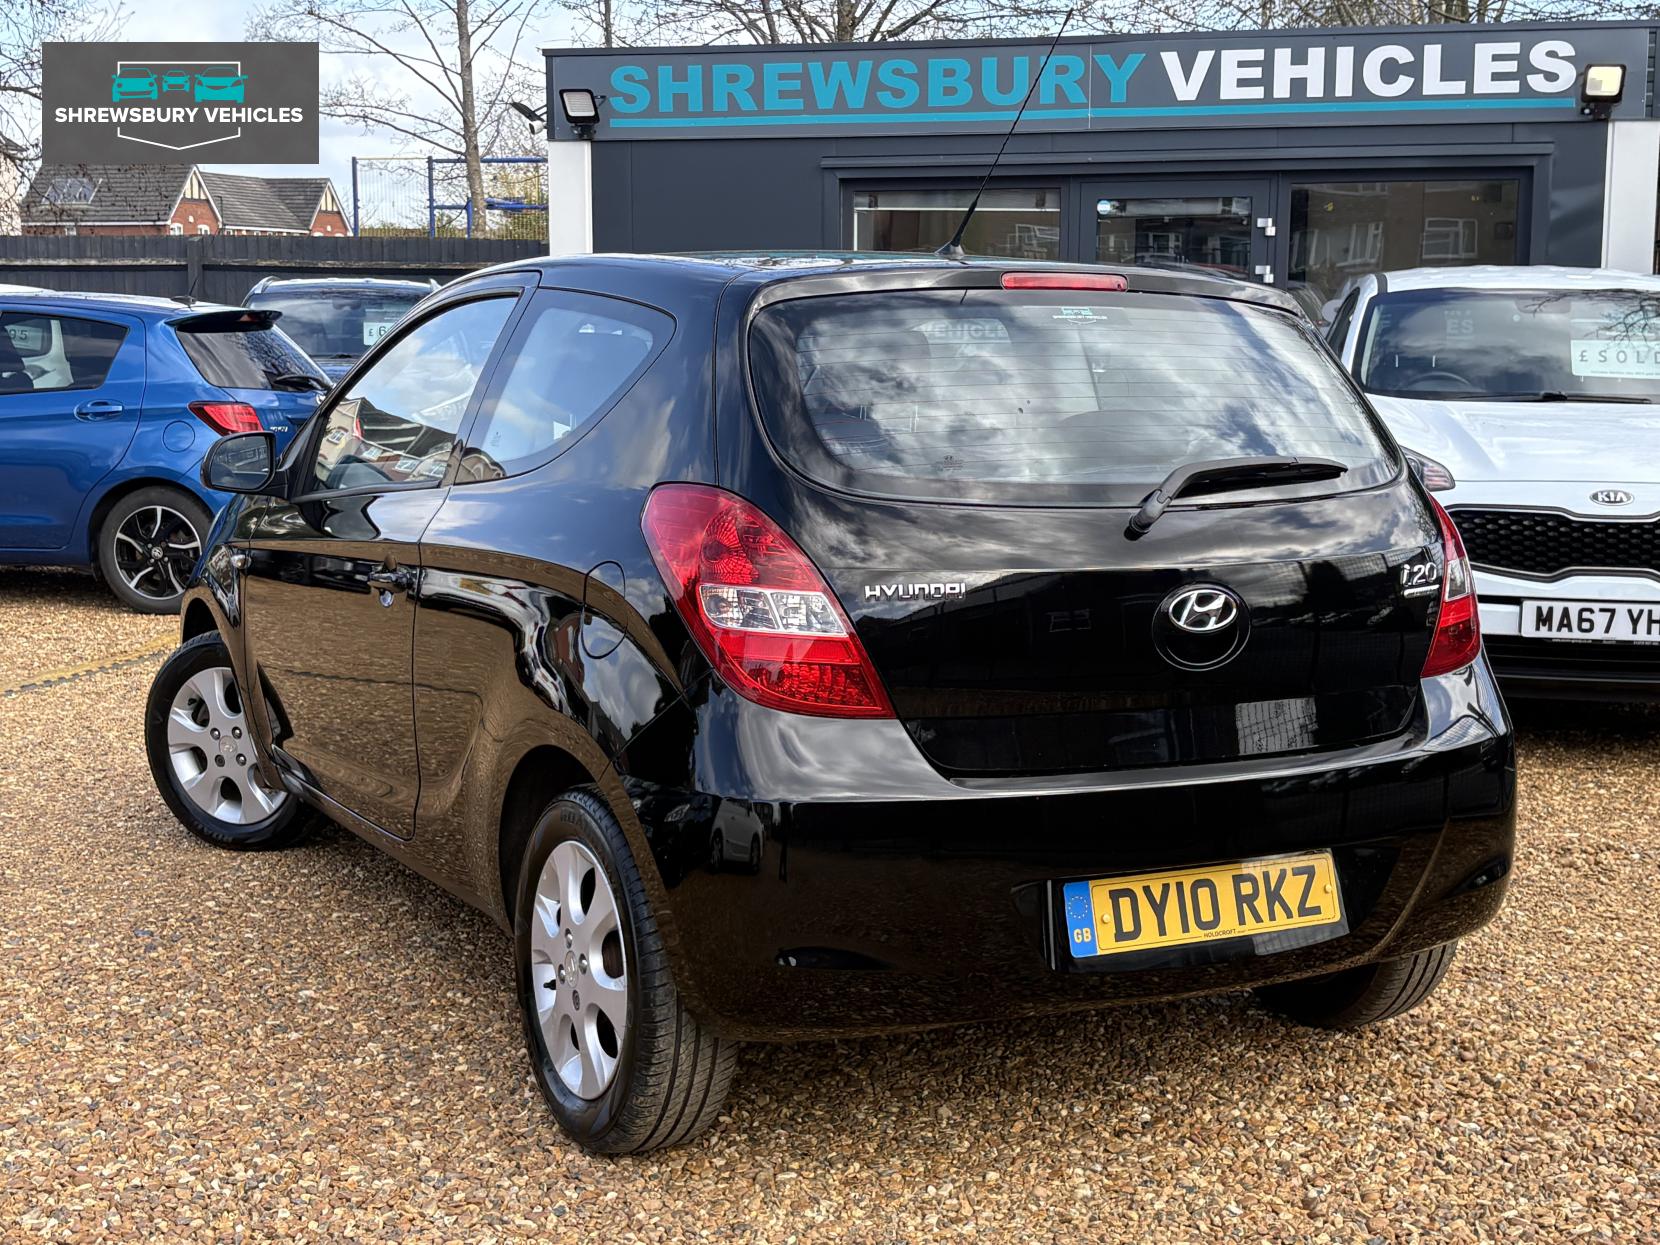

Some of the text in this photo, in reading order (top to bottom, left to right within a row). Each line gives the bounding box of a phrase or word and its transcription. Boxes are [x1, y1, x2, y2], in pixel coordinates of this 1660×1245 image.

[609, 40, 1578, 114] SHREWSBURY VEHICLES
[1597, 491, 1628, 502] KIA
[864, 582, 967, 601] HYUNDAI
[1535, 605, 1616, 634] MA67
[1108, 864, 1322, 943] DY10 RKZ
[1073, 927, 1092, 943] GB
